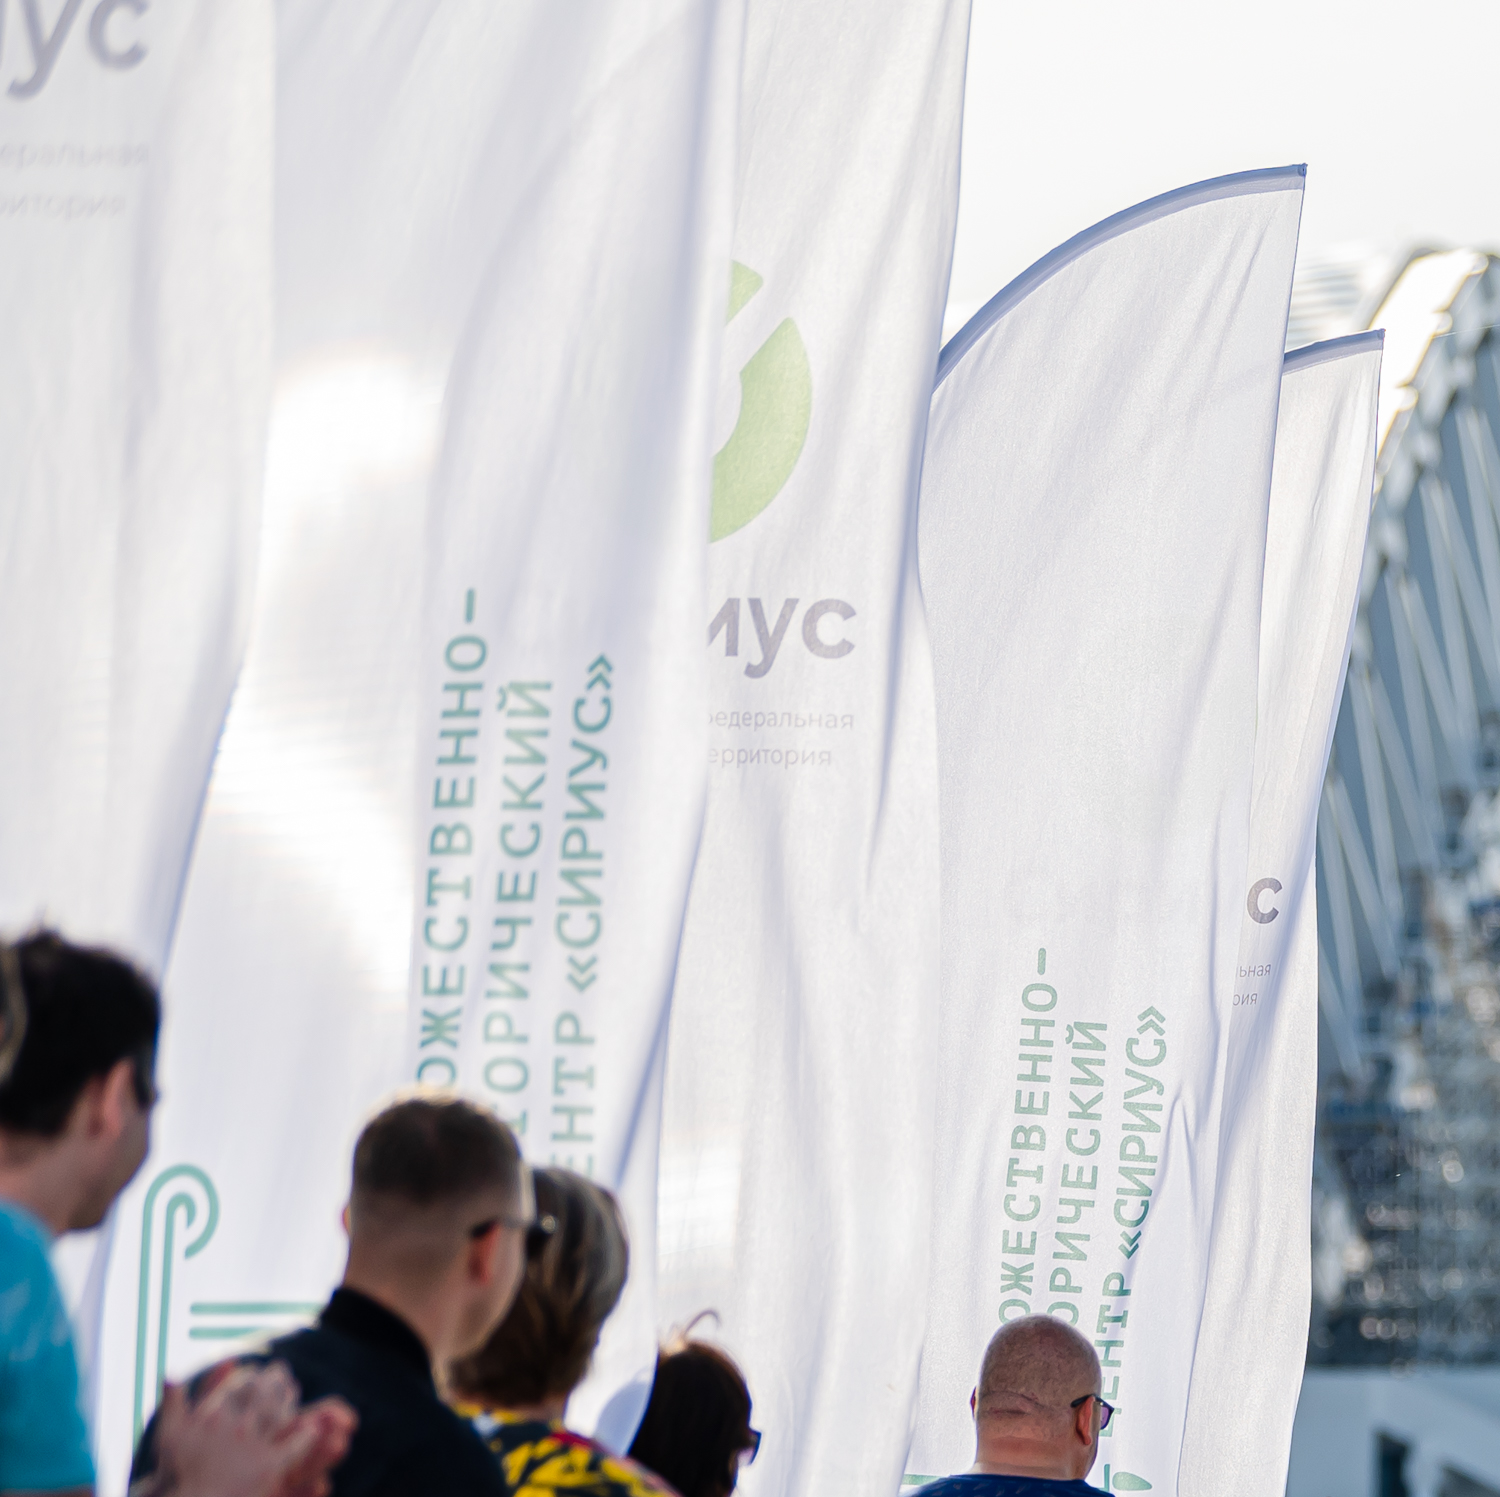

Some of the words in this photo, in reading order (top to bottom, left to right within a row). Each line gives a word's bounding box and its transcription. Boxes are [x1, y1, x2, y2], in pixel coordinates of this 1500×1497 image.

[0, 0, 149, 99] ус
[709, 711, 855, 731] едеральная
[555, 654, 614, 992] «СИРИУС»
[1235, 964, 1271, 978] ьная
[1112, 1005, 1167, 1259] «СИРИУС»
